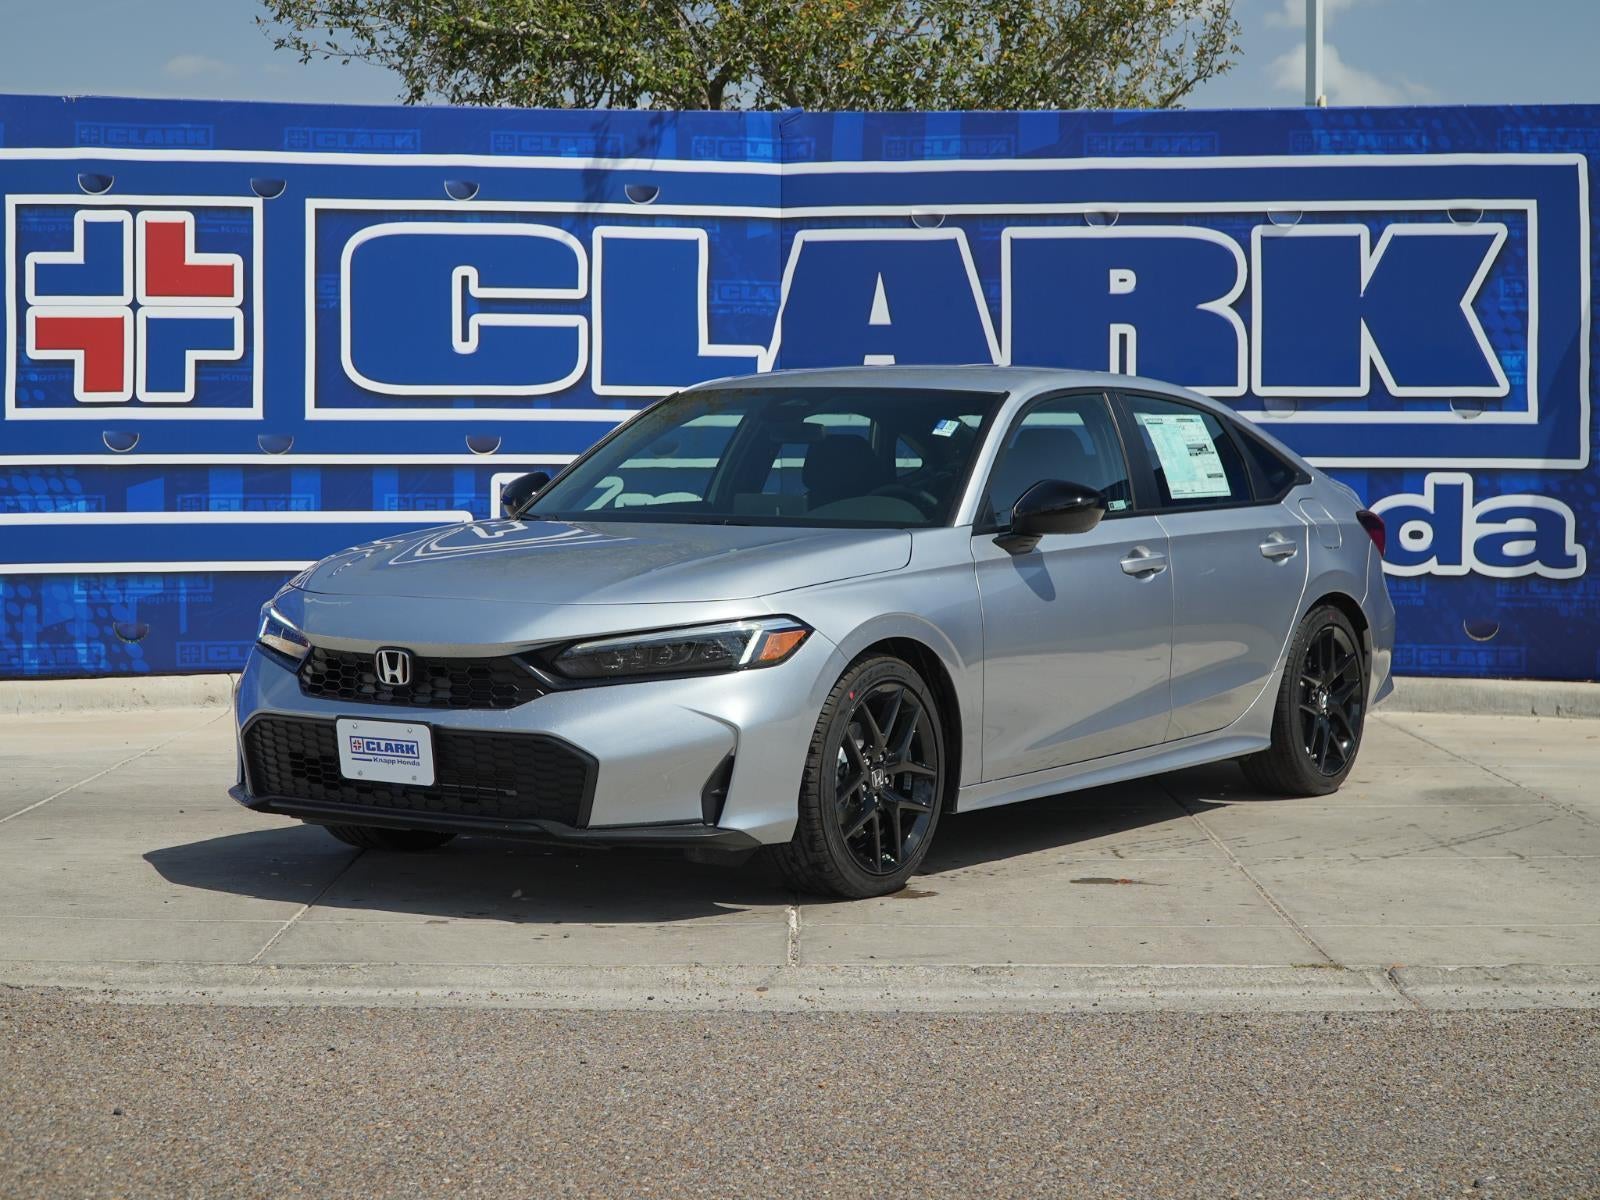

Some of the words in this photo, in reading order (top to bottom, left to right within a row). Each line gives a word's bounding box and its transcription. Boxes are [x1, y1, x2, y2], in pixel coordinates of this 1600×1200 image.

[106, 126, 209, 146] CLARK
[314, 132, 416, 149] CLARK
[341, 222, 1509, 397] CLARK
[366, 741, 416, 755] CLARK
[373, 757, 396, 765] Knapp
[397, 759, 420, 767] Honda
